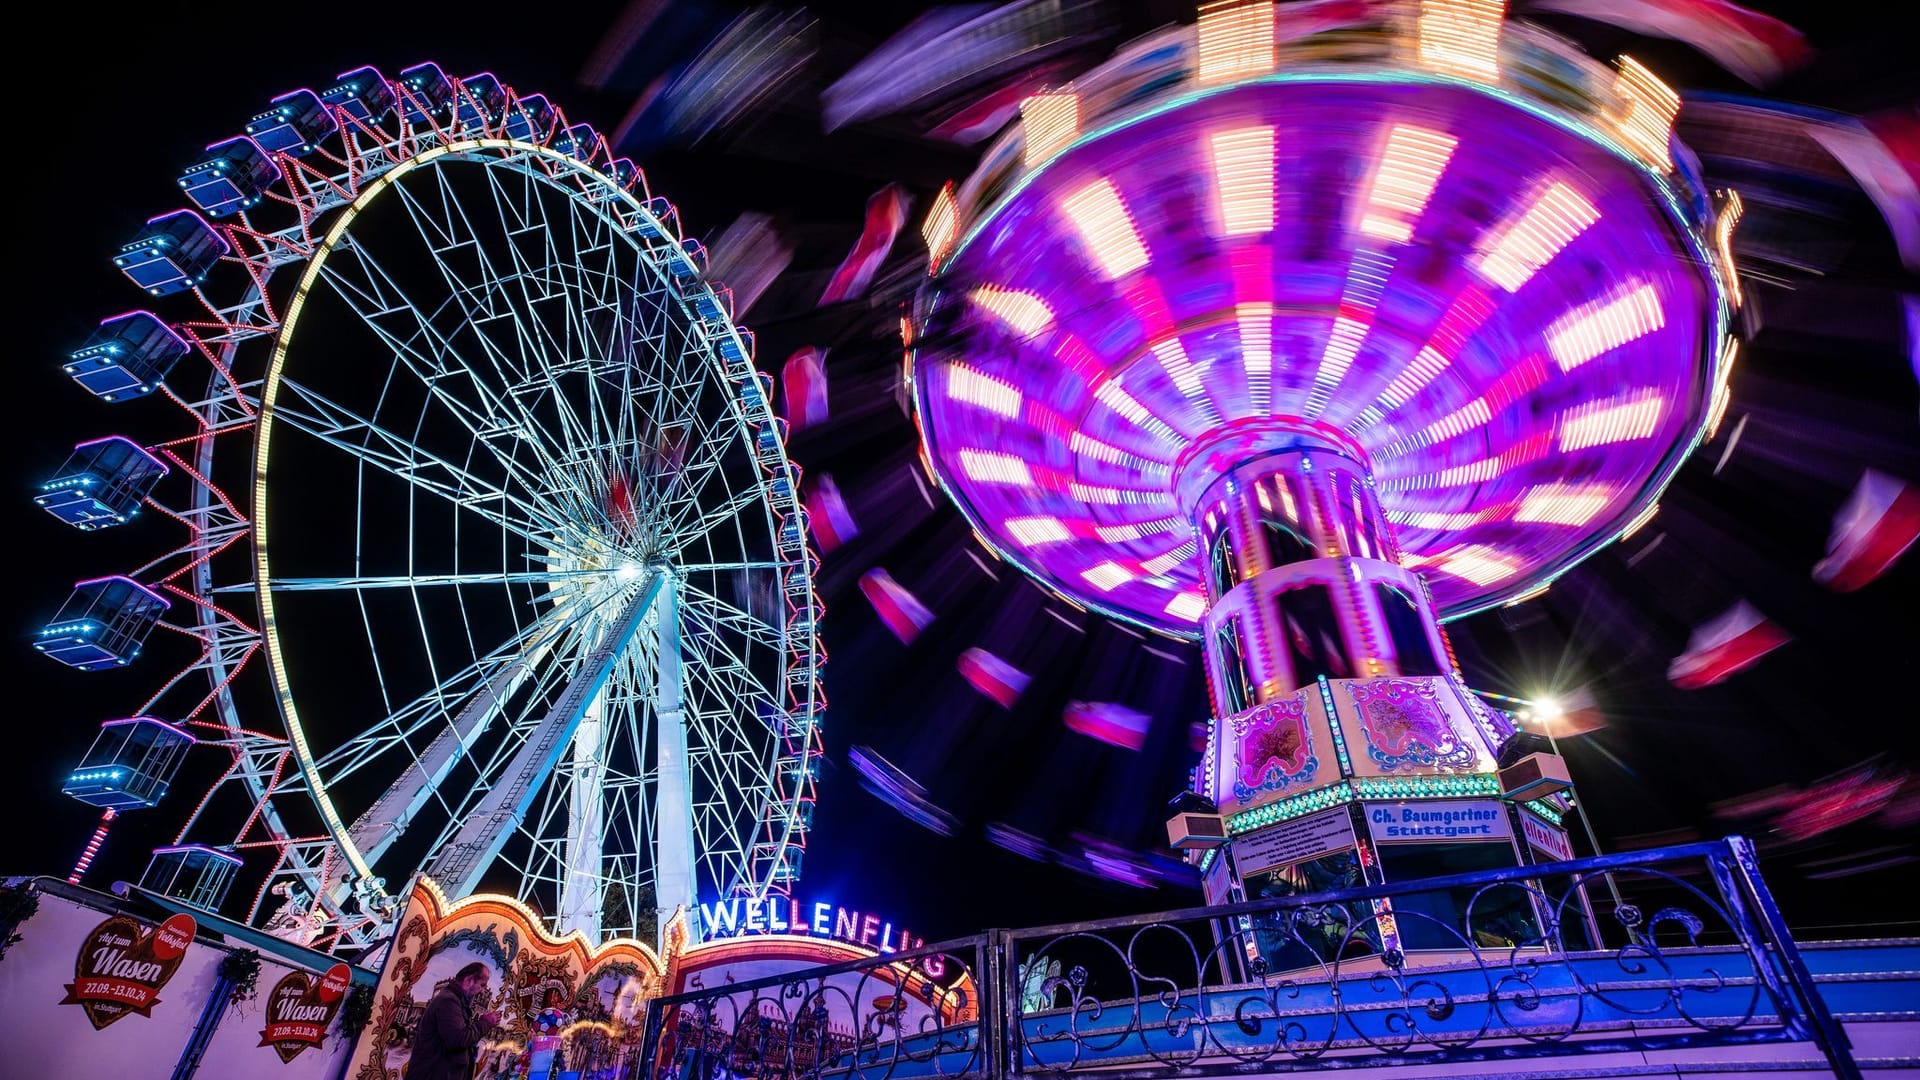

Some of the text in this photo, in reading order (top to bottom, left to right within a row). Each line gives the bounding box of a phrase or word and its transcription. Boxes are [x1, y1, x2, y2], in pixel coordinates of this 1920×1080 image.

[1372, 808, 1498, 825] Ch. Baumgartner
[1387, 824, 1491, 837] Stuttgart
[1520, 815, 1570, 860] ellenflug
[98, 932, 131, 947] Auf zum
[92, 947, 162, 982] Wasen
[277, 998, 328, 1021] Wasen
